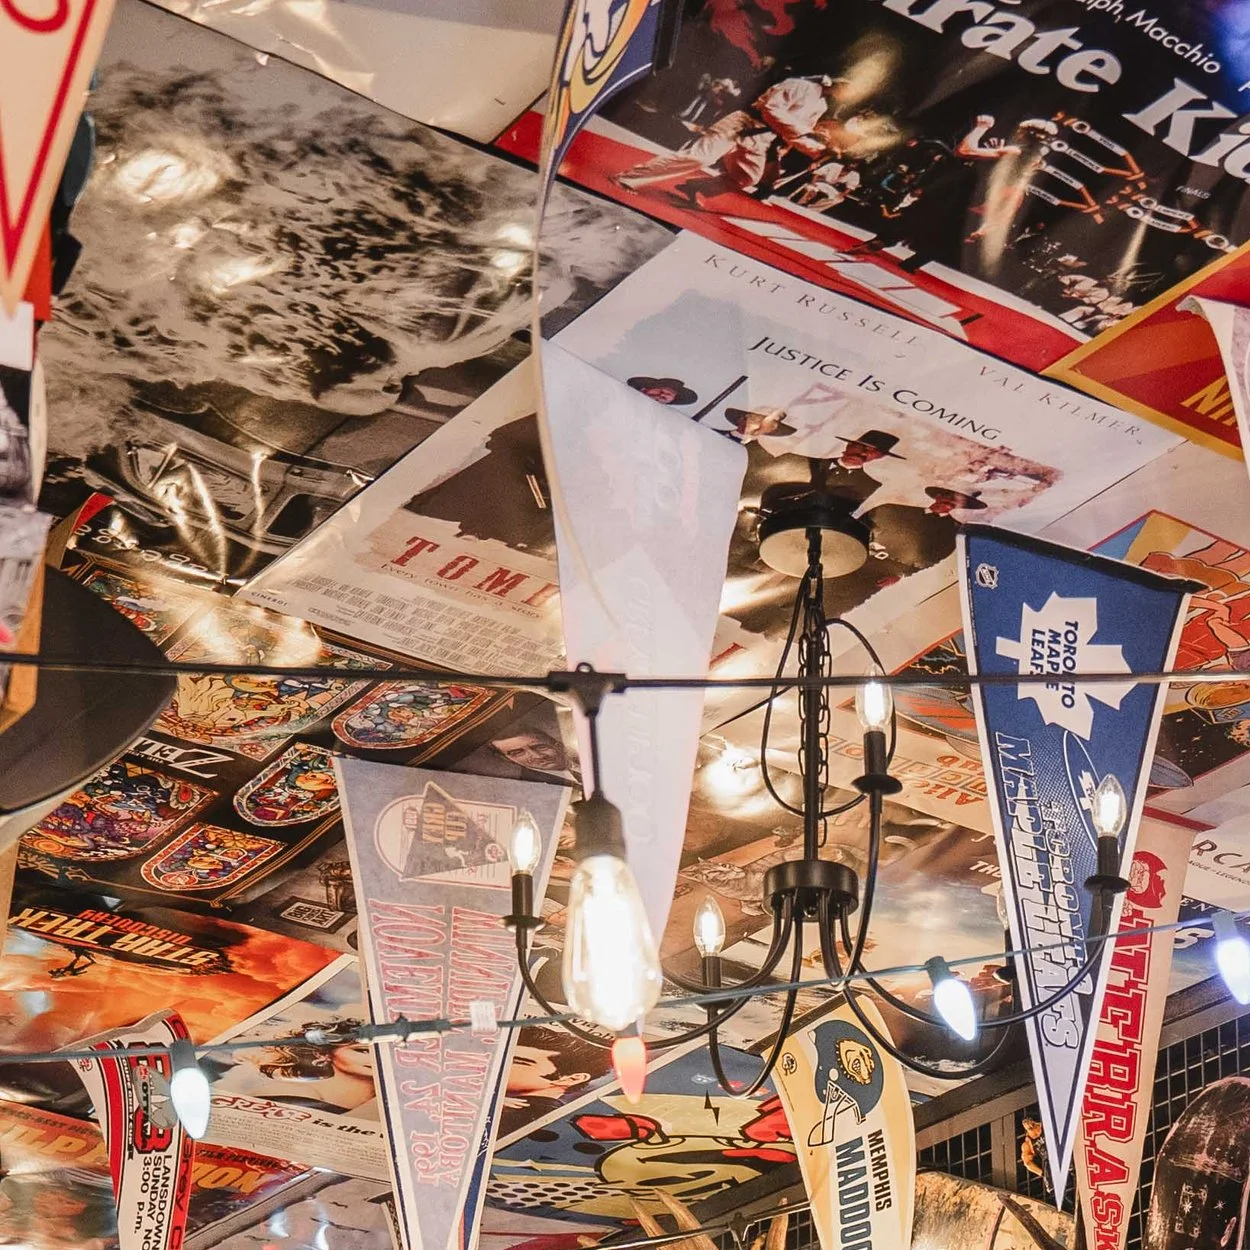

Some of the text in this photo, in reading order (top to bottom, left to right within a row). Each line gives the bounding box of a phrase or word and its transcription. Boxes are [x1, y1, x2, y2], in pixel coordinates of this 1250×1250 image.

[1127, 10, 1222, 75] Macchio
[703, 253, 920, 348] KURT RUSSELL
[748, 335, 852, 382] JUSTICE
[891, 387, 1002, 442] COMING
[978, 364, 1144, 438] VAL KILMER
[1061, 619, 1080, 711] TOROTO
[76, 908, 194, 945] DISCOVERY
[994, 731, 1080, 1050] MAPLE LEAFS
[6, 907, 222, 969] STAR TREK
[311, 1117, 333, 1129] is
[336, 1124, 377, 1139] the
[133, 1155, 153, 1235] 3:00 p.m.
[146, 1155, 160, 1222] SUNDAY
[868, 1128, 893, 1214] MEMPHIS
